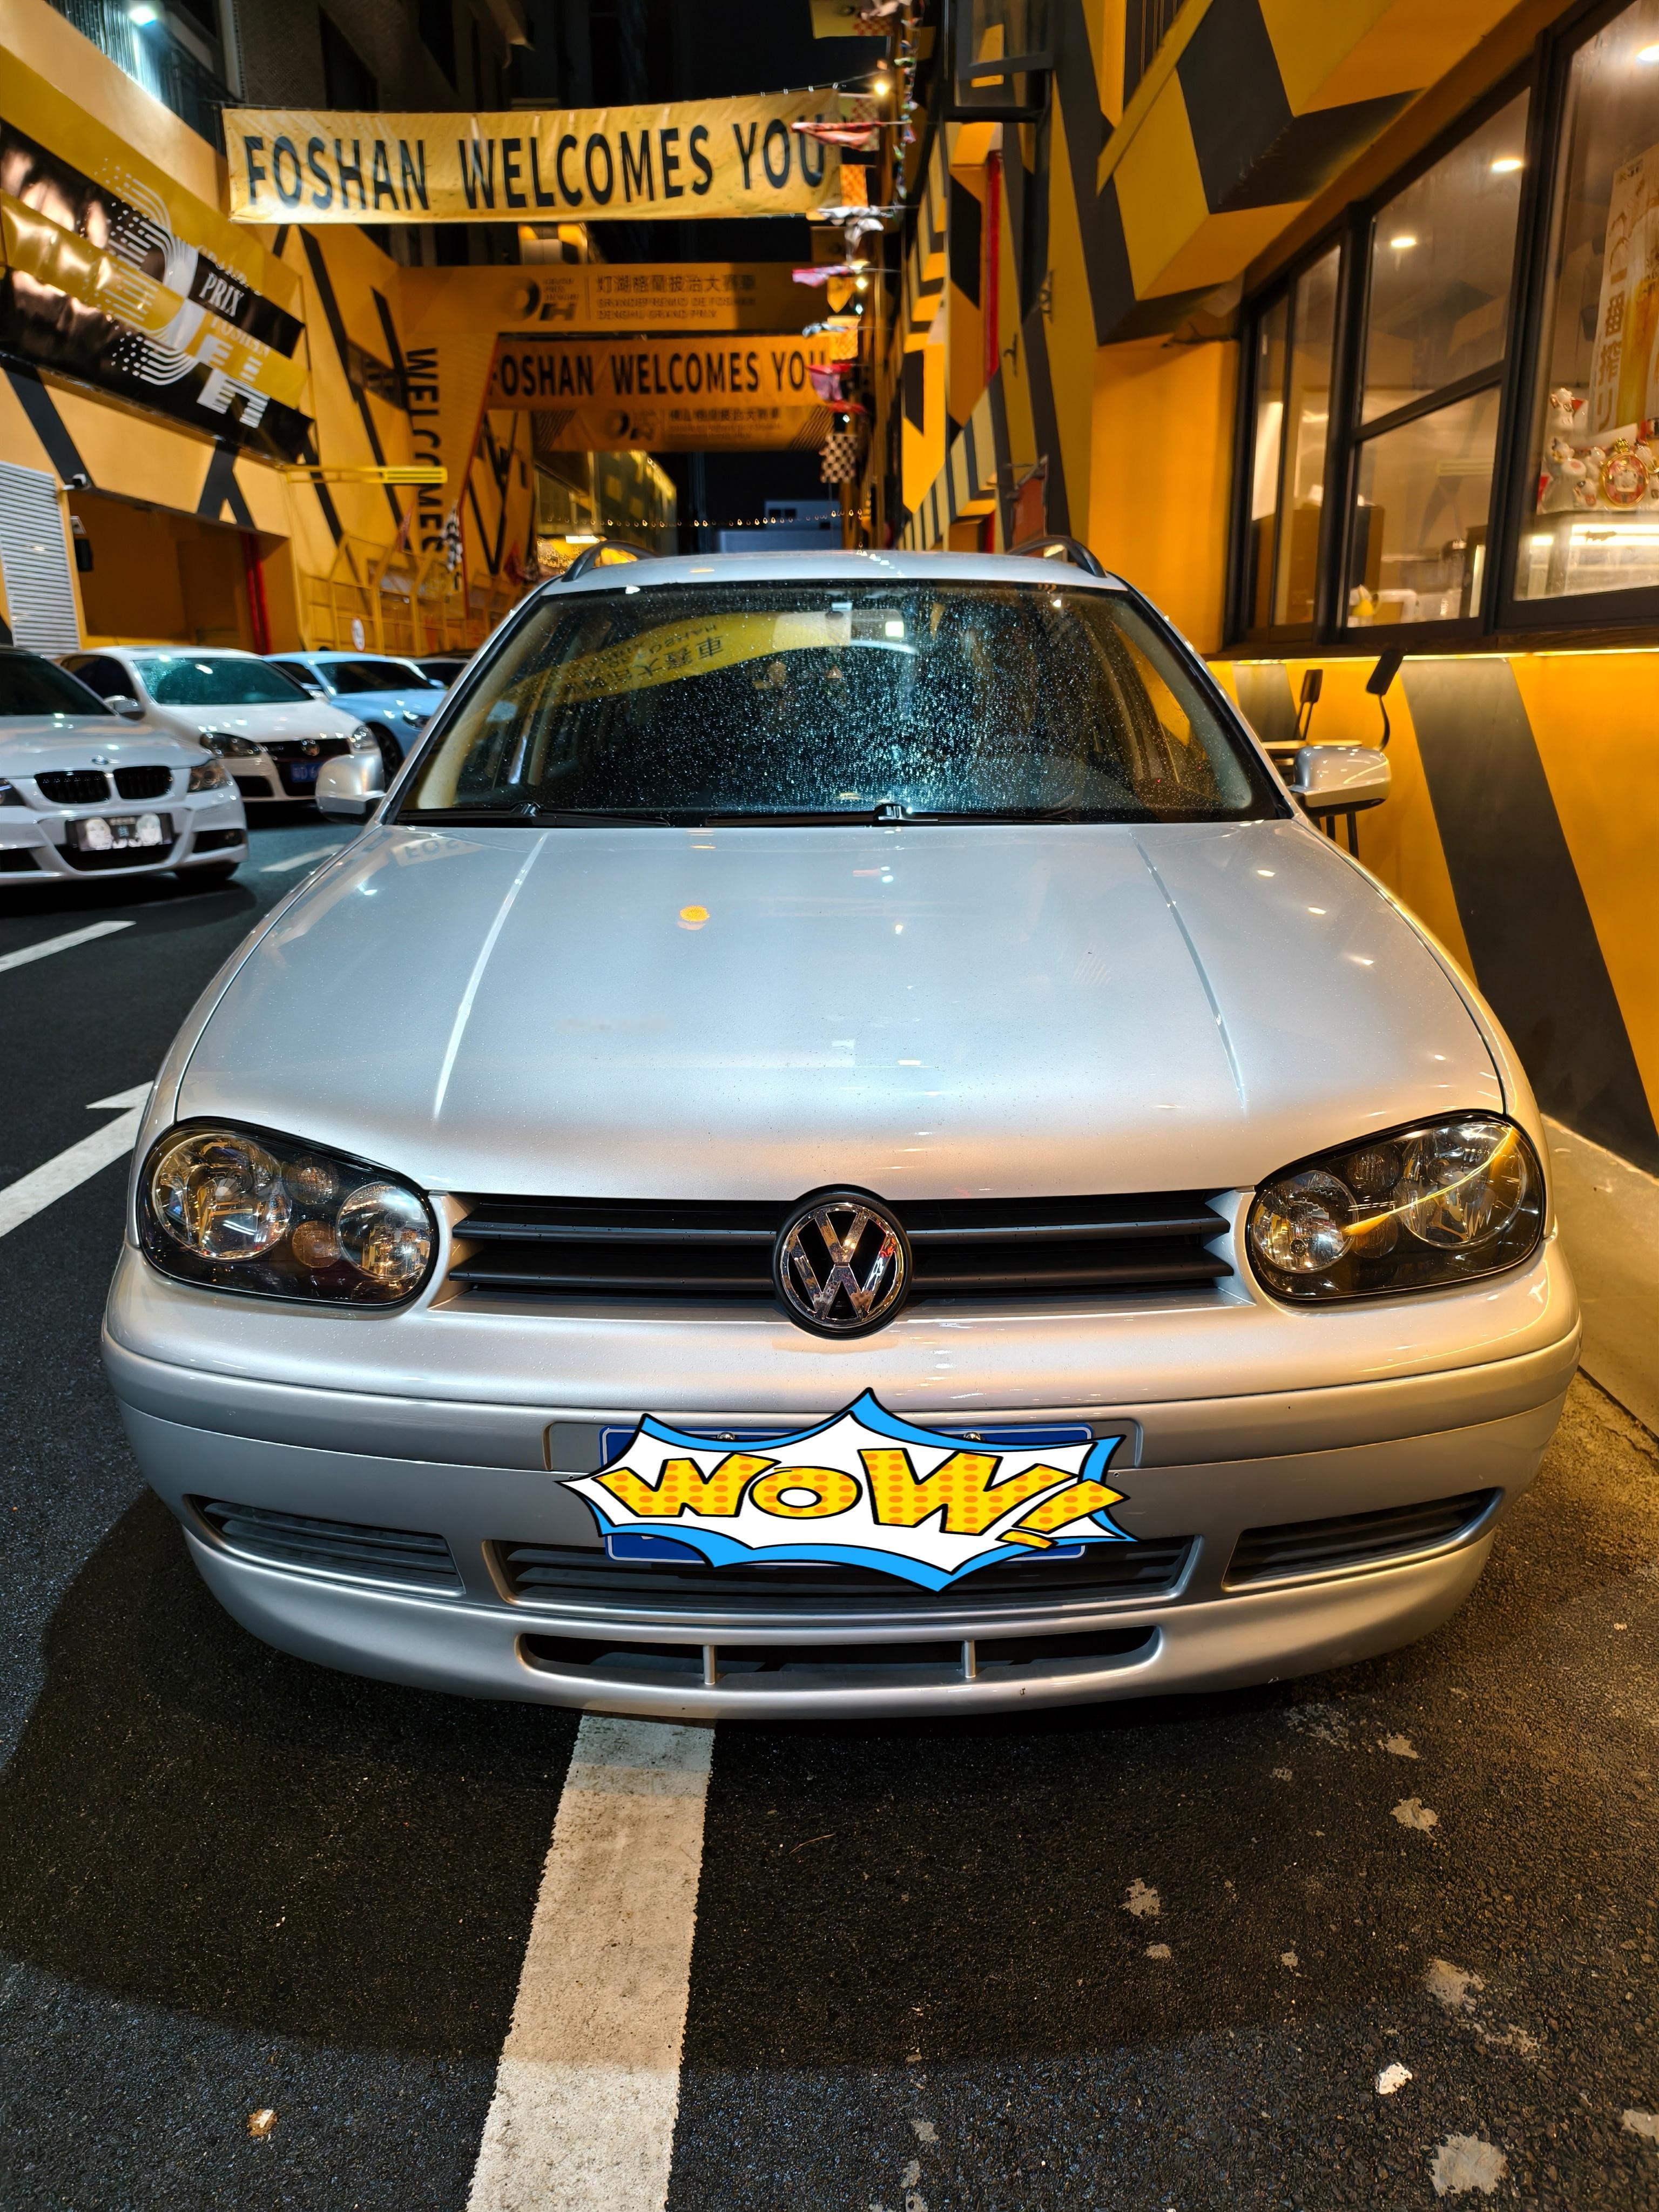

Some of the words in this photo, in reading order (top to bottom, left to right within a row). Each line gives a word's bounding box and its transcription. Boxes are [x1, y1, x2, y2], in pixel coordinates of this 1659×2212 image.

[244, 134, 429, 211] FOSHAN
[458, 124, 713, 210] WELCOMES
[732, 110, 826, 190] YOU
[199, 272, 244, 318] PRIX
[611, 352, 759, 395] WELCOMES
